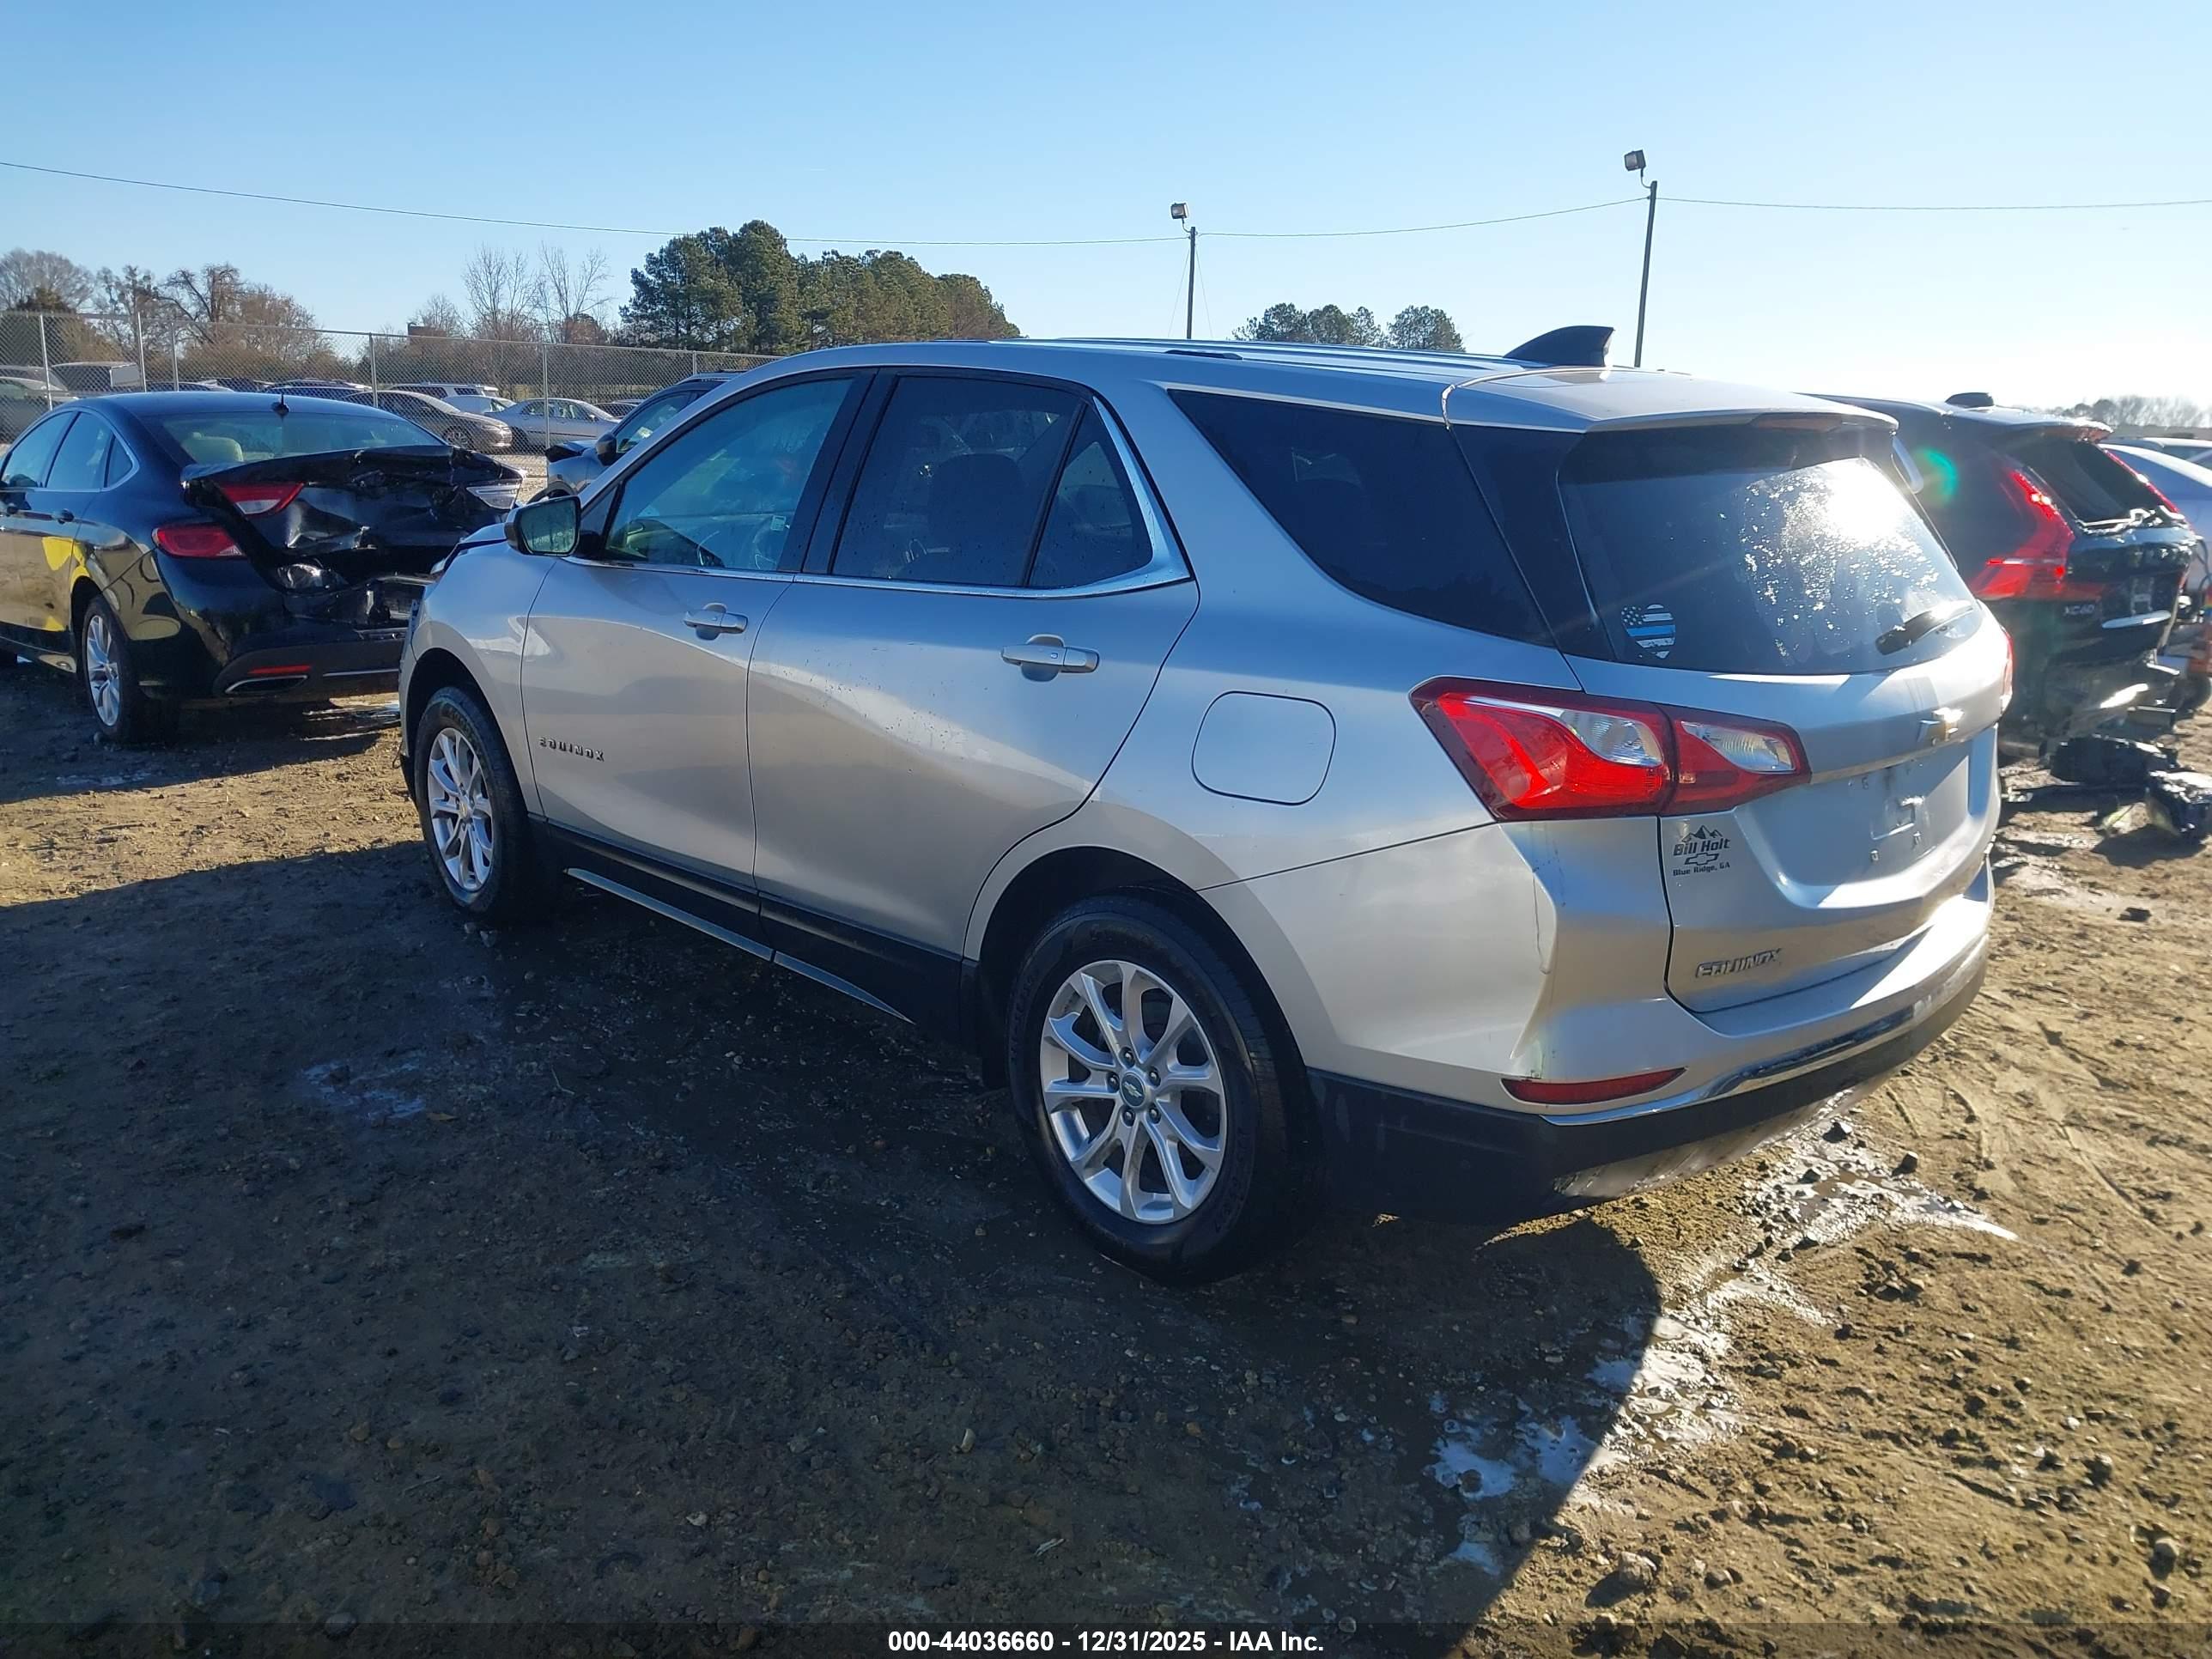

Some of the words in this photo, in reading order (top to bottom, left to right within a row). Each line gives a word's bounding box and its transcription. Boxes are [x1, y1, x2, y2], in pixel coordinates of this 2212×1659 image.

[538, 737, 605, 762] EQUINOX
[1673, 842, 1698, 856] Bill
[1700, 837, 1730, 853] Holt
[1695, 947, 1782, 978] EQUINOX
